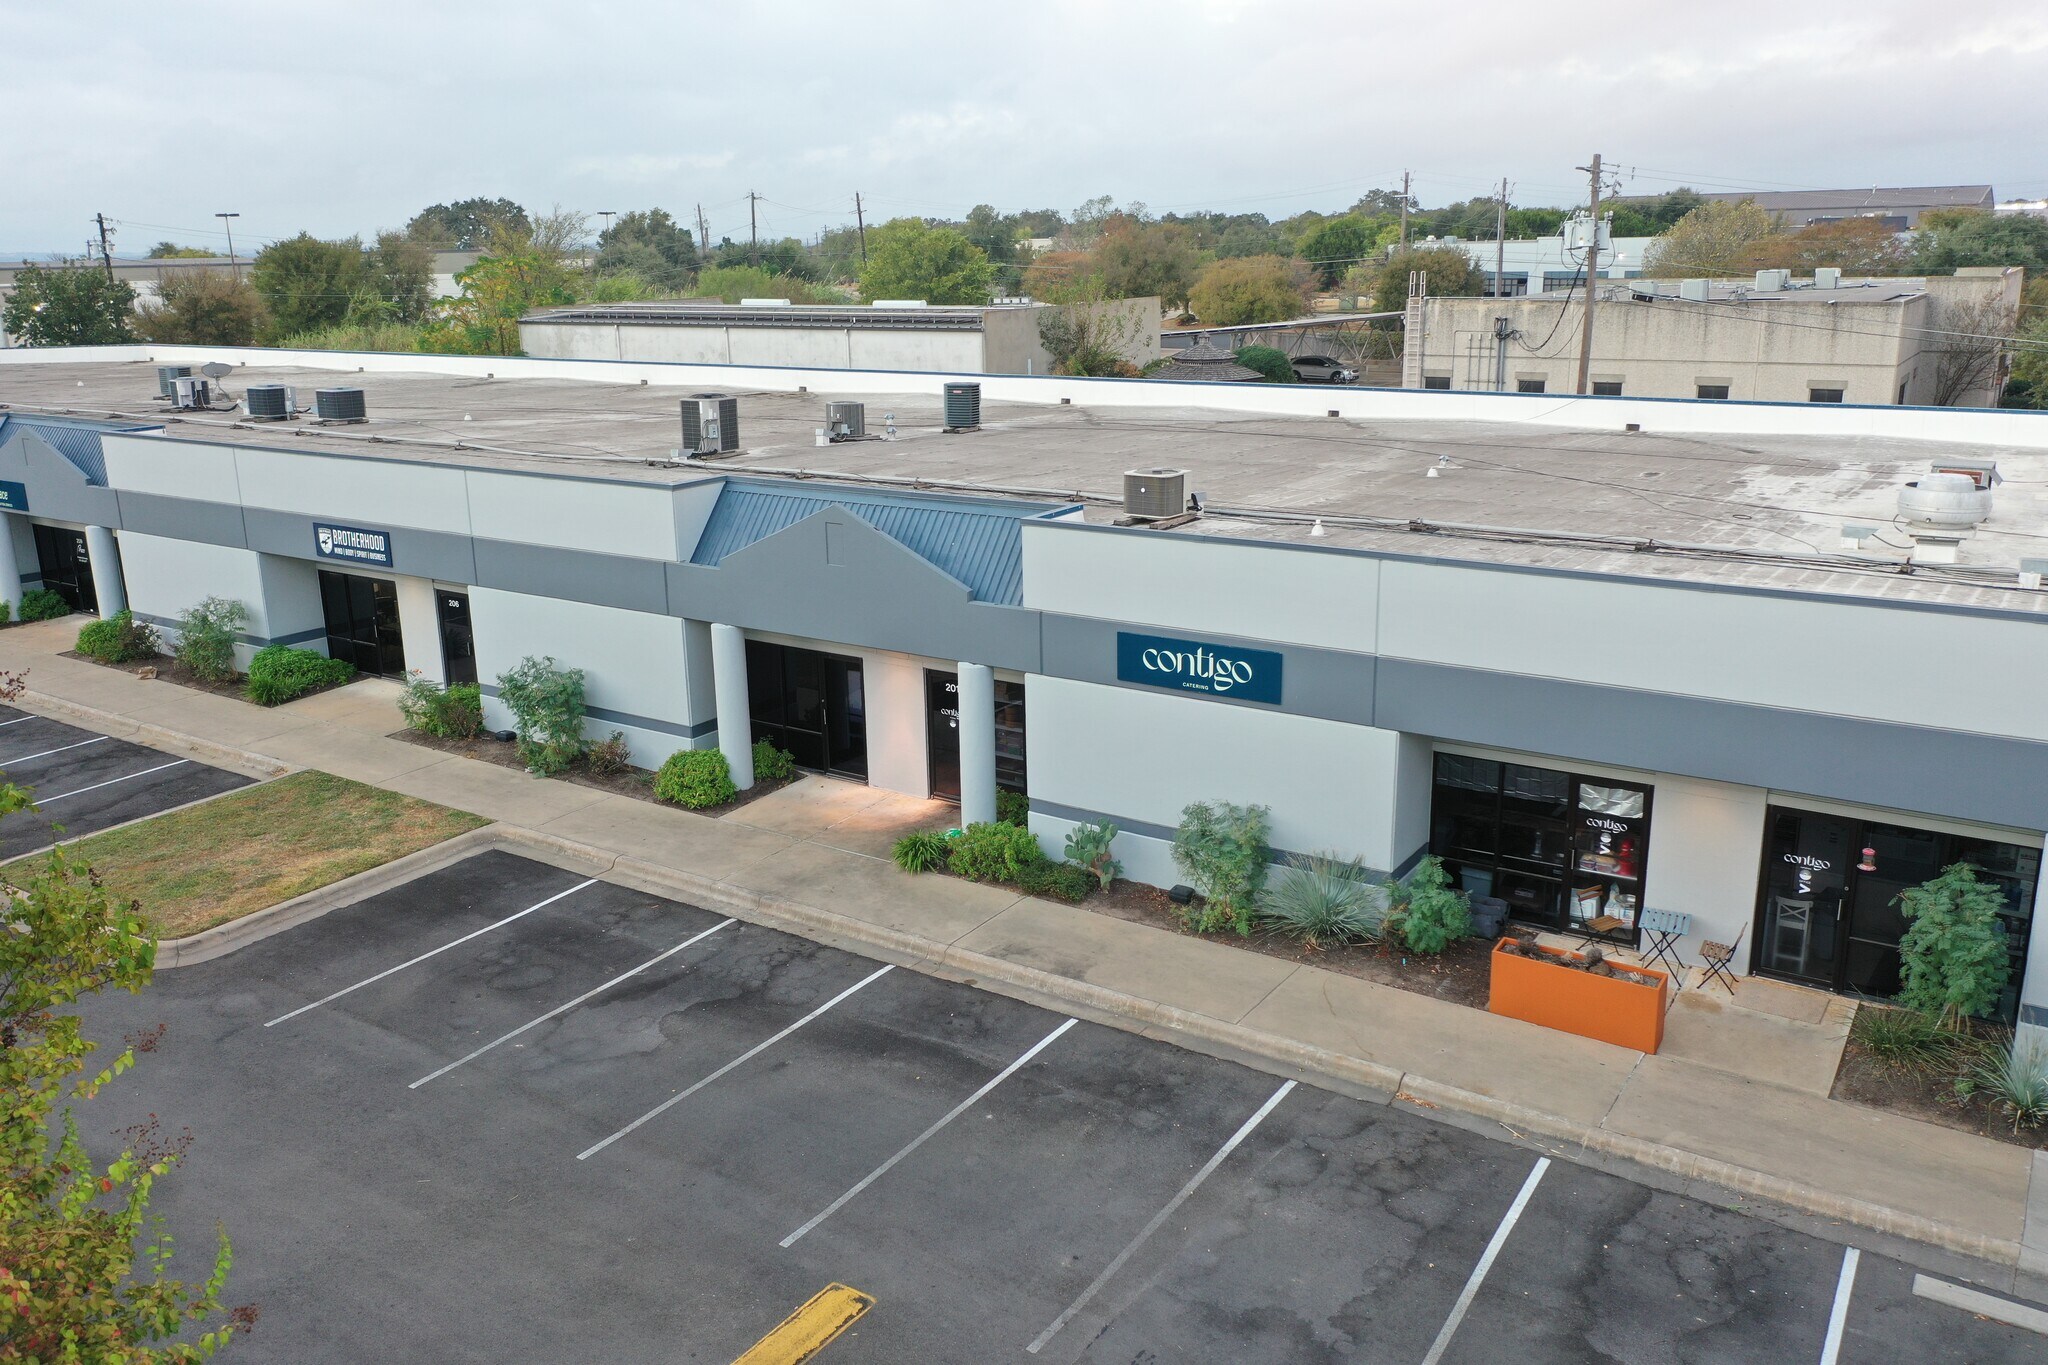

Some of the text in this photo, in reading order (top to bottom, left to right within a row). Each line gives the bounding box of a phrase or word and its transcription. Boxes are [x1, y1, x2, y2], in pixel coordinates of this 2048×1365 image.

[332, 529, 385, 552] BROTHERHOOD
[334, 547, 343, 555] MIND
[448, 599, 460, 608] 206
[1142, 646, 1253, 692] contigo
[1182, 681, 1209, 691] CATERING
[1586, 818, 1628, 834] contigo
[1783, 853, 1831, 871] contigo
